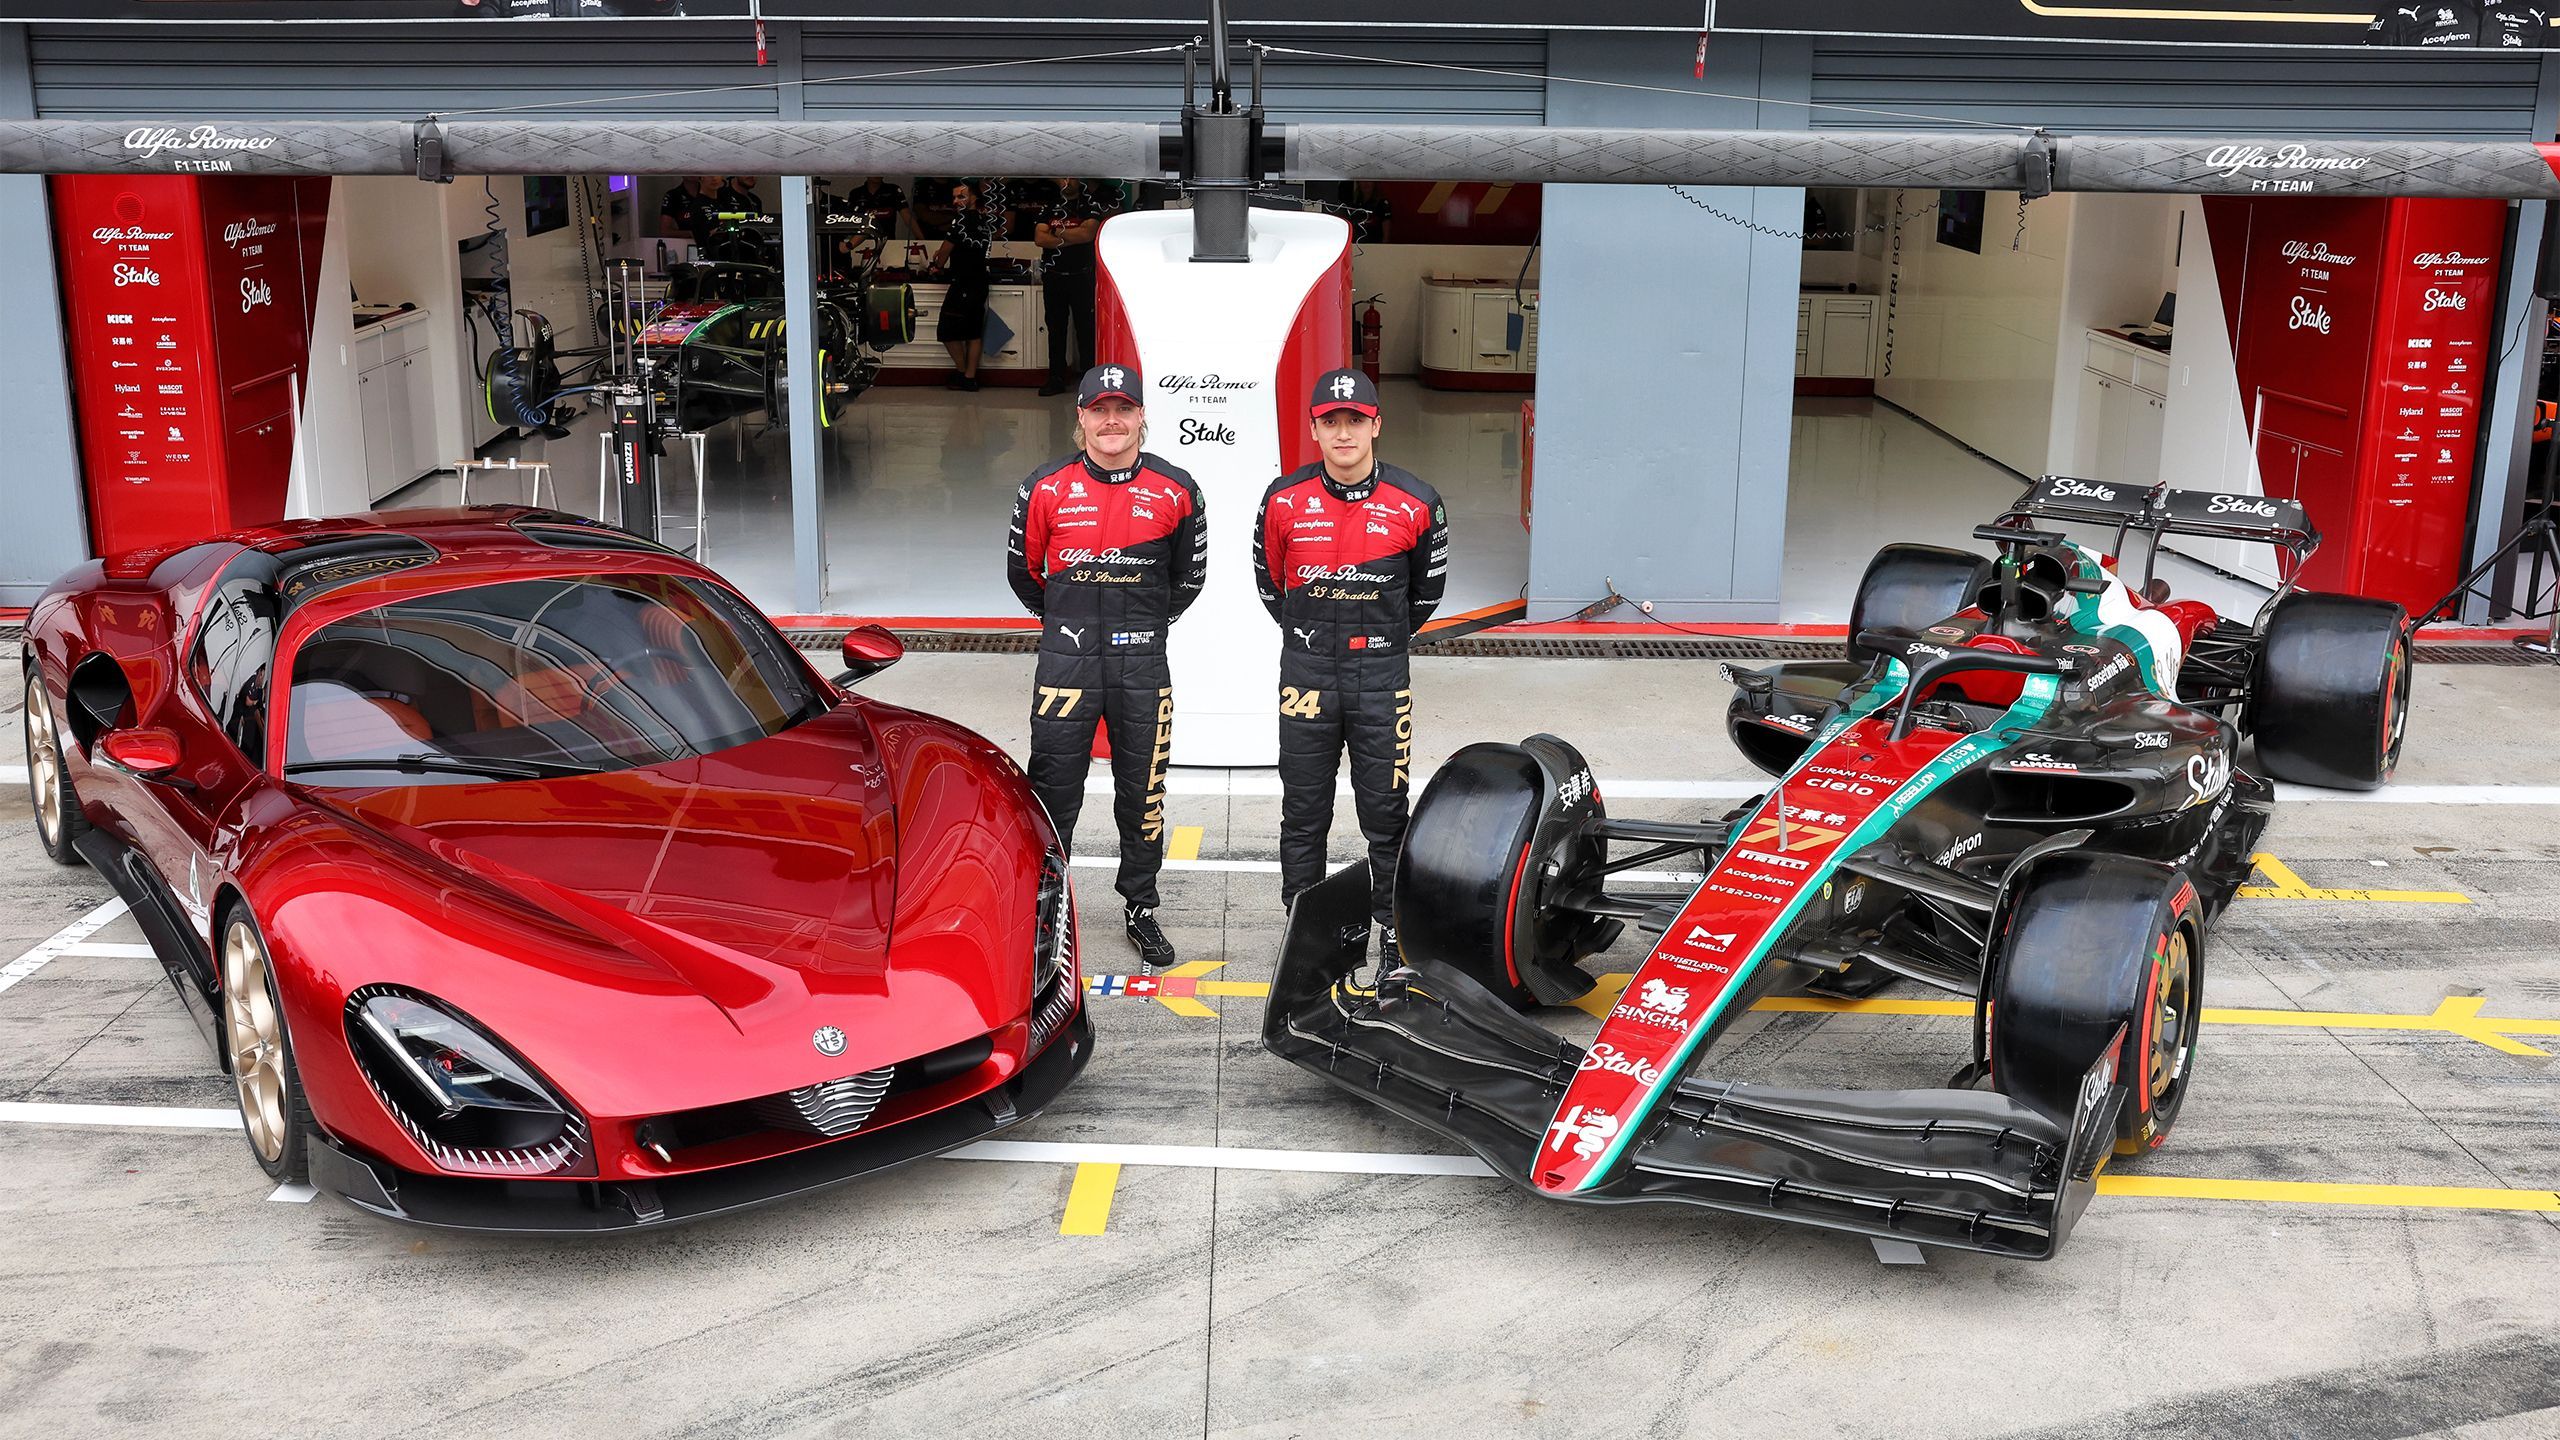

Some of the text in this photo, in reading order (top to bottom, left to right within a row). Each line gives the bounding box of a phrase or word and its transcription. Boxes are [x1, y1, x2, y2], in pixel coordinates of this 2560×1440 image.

[124, 125, 277, 158] Alfa Romeo
[174, 160, 233, 172] F1 TEAM
[2206, 143, 2371, 177] Alfa Romeo
[2251, 180, 2314, 192] F1 TEAM
[825, 213, 862, 225] Stake
[92, 226, 174, 244] Alfa Romeo
[224, 217, 277, 249] Alfa Romeo
[119, 244, 150, 252] F1 TEAM
[242, 245, 263, 258] F1 TEAM
[2281, 240, 2356, 266] Alfa Romeo
[2413, 251, 2490, 269] Alfa Romeo
[112, 262, 160, 287] Stake
[2301, 267, 2330, 281] F1 TEAM
[240, 277, 272, 314] Stake
[2423, 288, 2467, 312] Stake
[107, 314, 133, 324] KICK
[1884, 273, 1899, 377] VALTTERI
[2289, 295, 2331, 335] Stake
[2408, 339, 2432, 348] KICK
[114, 384, 141, 394] Hyland
[1159, 373, 1259, 394] Alfa Romeo
[1202, 396, 1227, 404] TEAM
[2399, 407, 2423, 417] Hyland
[1179, 418, 1235, 446] Stake
[624, 442, 635, 485] CAMOZZI
[2049, 478, 2117, 502] Stake
[2207, 494, 2278, 519] Stake
[1059, 547, 1156, 567] Alfa Romeo
[1070, 570, 1143, 583] 33 Stradale
[1297, 564, 1395, 584] Alfa Romeo
[1327, 588, 1380, 600] Stradale
[1906, 642, 1950, 660] Stake
[2087, 661, 2119, 692] sensetime
[1038, 686, 1082, 718] 77
[1280, 686, 1321, 719] 24
[1392, 689, 1412, 789] ZHOU
[2134, 731, 2169, 749] Stake
[1141, 686, 1173, 843] VALTTERI
[1938, 747, 1969, 765] WEB
[1951, 749, 1988, 774] EYEWEAR
[2010, 759, 2078, 770] CAMOZZI
[1805, 776, 1874, 796] cielo
[1809, 765, 1897, 786] CURAM DOMI
[1558, 767, 1592, 812] 安慕希
[1895, 771, 1937, 811] REBELLION
[1776, 805, 1847, 827] 安慕希
[1739, 817, 1848, 852] 77
[1737, 849, 1810, 871] PIRELLI
[1709, 884, 1782, 904] EVERDOME
[1683, 939, 1727, 953] MARELLI
[1614, 1004, 1688, 1031] SINGHA
[1578, 1042, 1661, 1087] Stake
[2080, 1059, 2113, 1134] Stake
